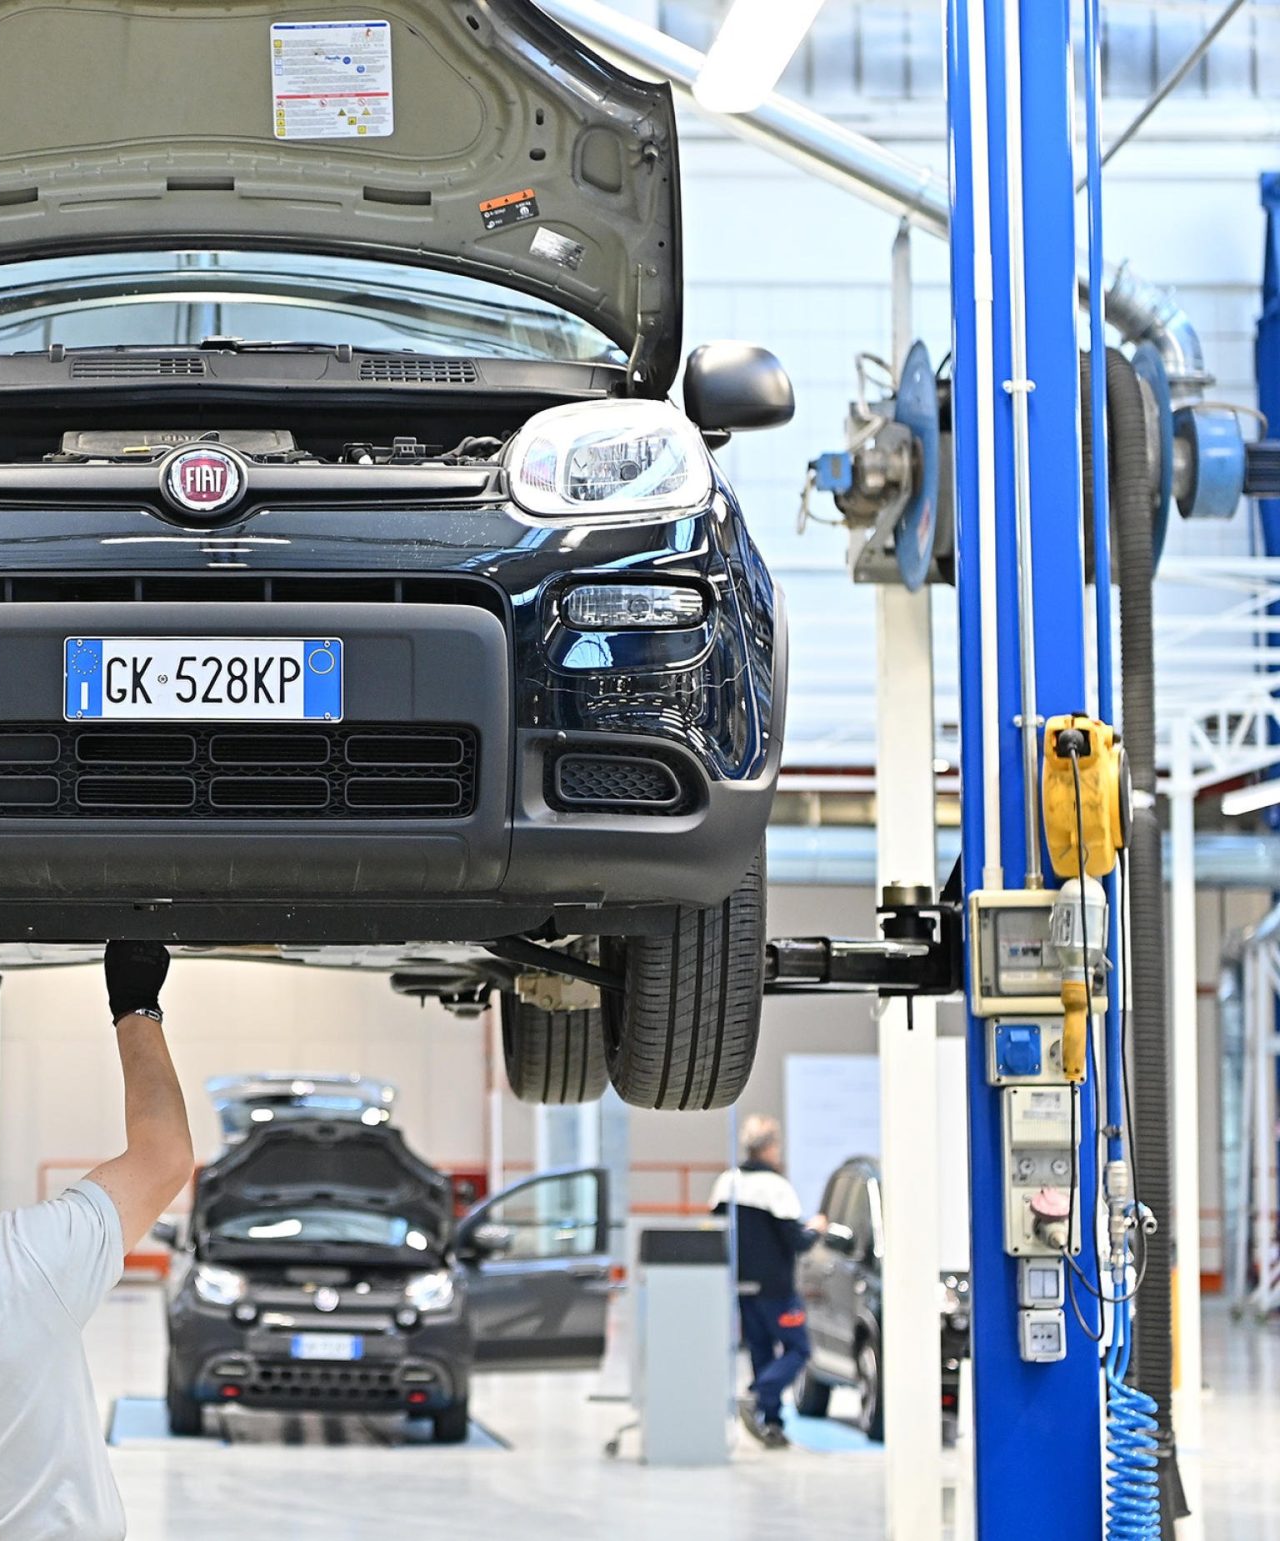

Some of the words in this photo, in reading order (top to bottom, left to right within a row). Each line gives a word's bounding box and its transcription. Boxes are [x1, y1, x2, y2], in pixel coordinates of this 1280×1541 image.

[185, 464, 225, 493] FIAT
[105, 656, 153, 704] GK
[175, 656, 301, 704] 528KP
